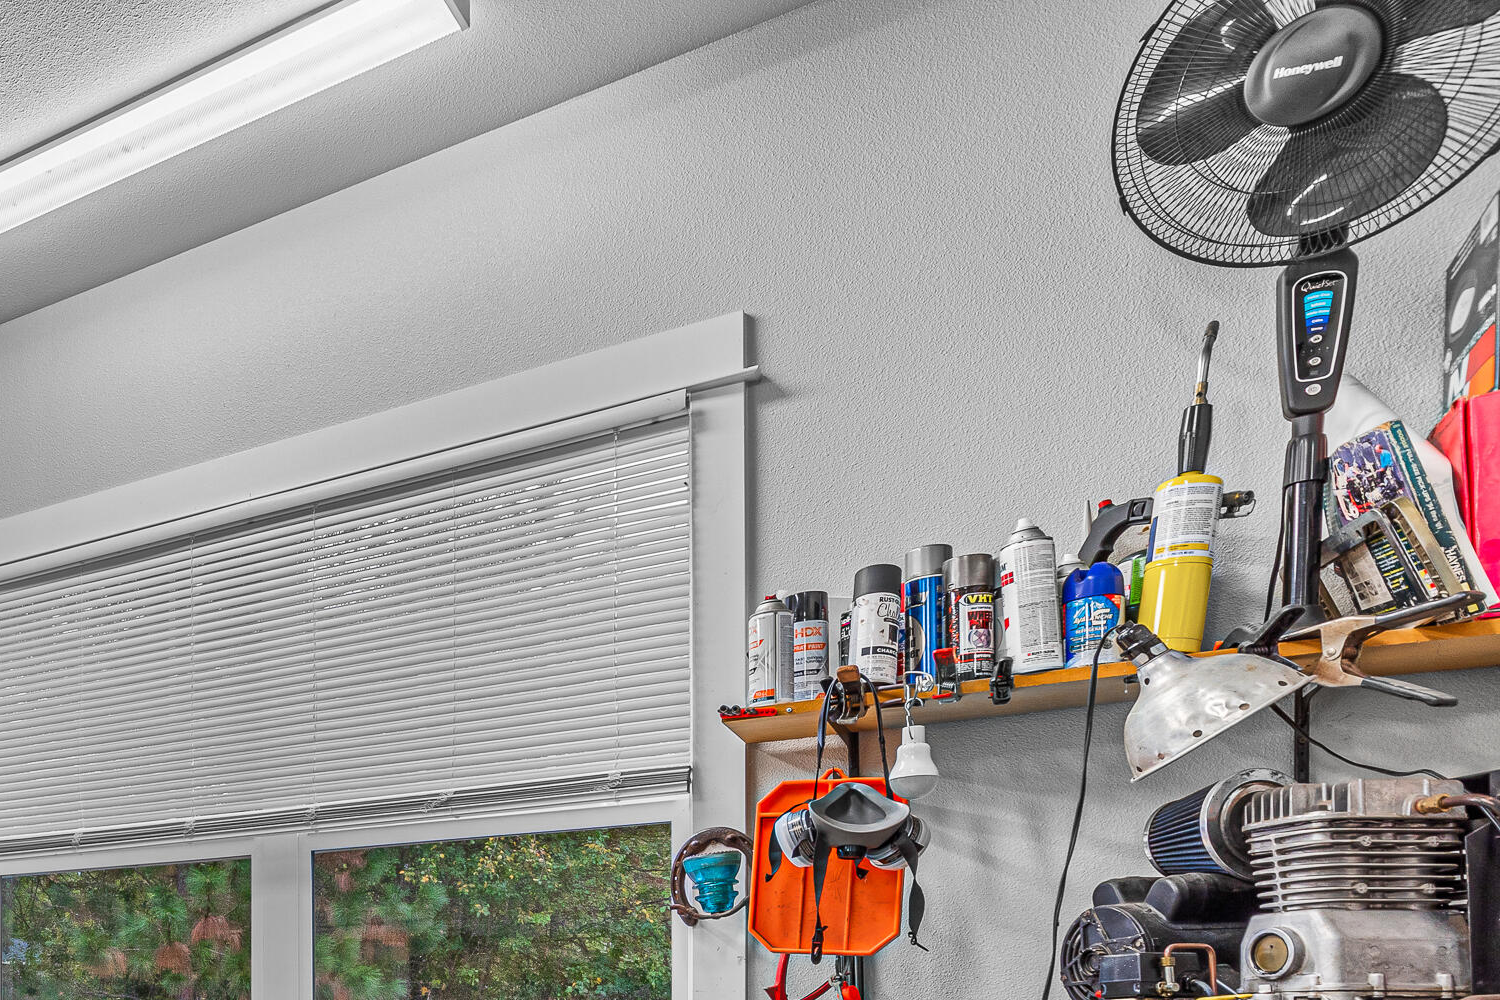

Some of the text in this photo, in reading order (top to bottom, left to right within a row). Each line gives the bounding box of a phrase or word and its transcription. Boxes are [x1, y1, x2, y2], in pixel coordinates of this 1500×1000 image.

[1273, 56, 1343, 79] Honeywell
[1445, 548, 1466, 583] HAYNES
[968, 594, 993, 603] VHT
[795, 626, 823, 639] HDX
